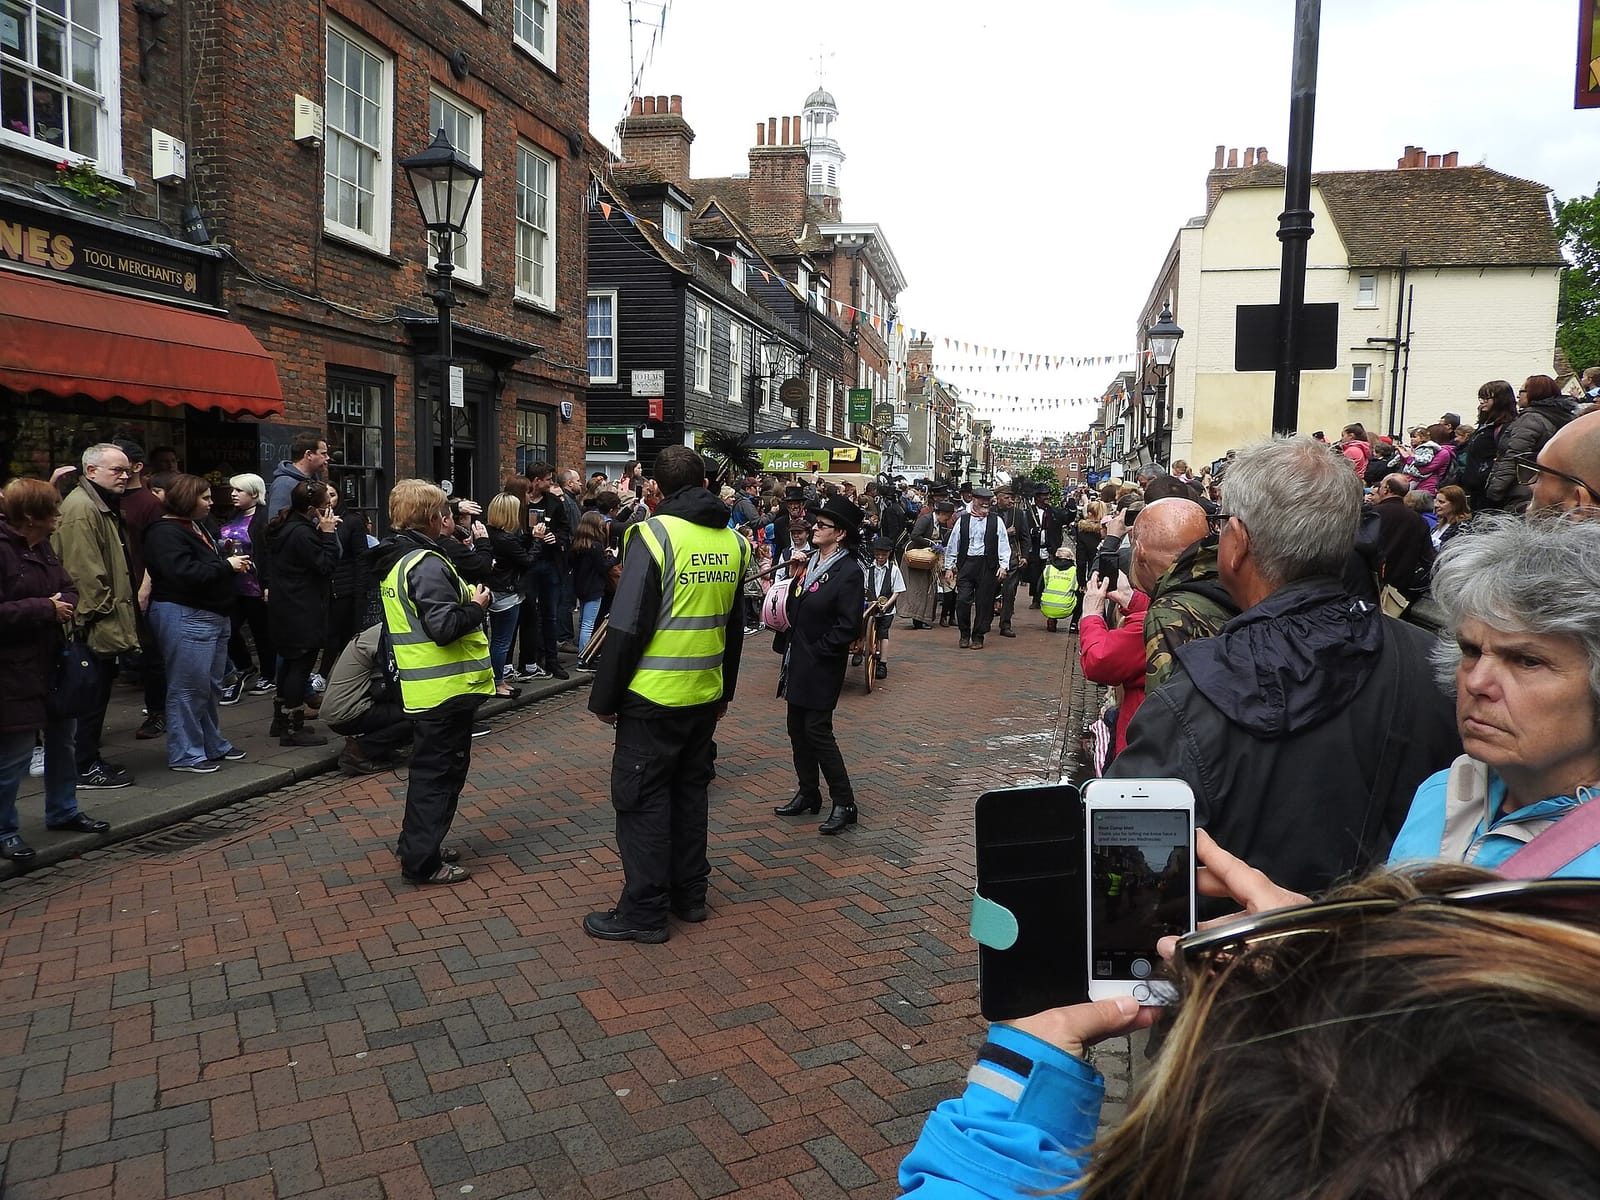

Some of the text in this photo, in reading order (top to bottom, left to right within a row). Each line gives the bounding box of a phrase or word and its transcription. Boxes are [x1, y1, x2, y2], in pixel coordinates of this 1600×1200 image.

[0, 220, 75, 270] NES
[83, 249, 115, 269] TOOL
[118, 257, 183, 285] MERCHANTS
[767, 459, 805, 470] Apples
[691, 553, 729, 566] EVENT
[680, 570, 736, 584] STEWARD
